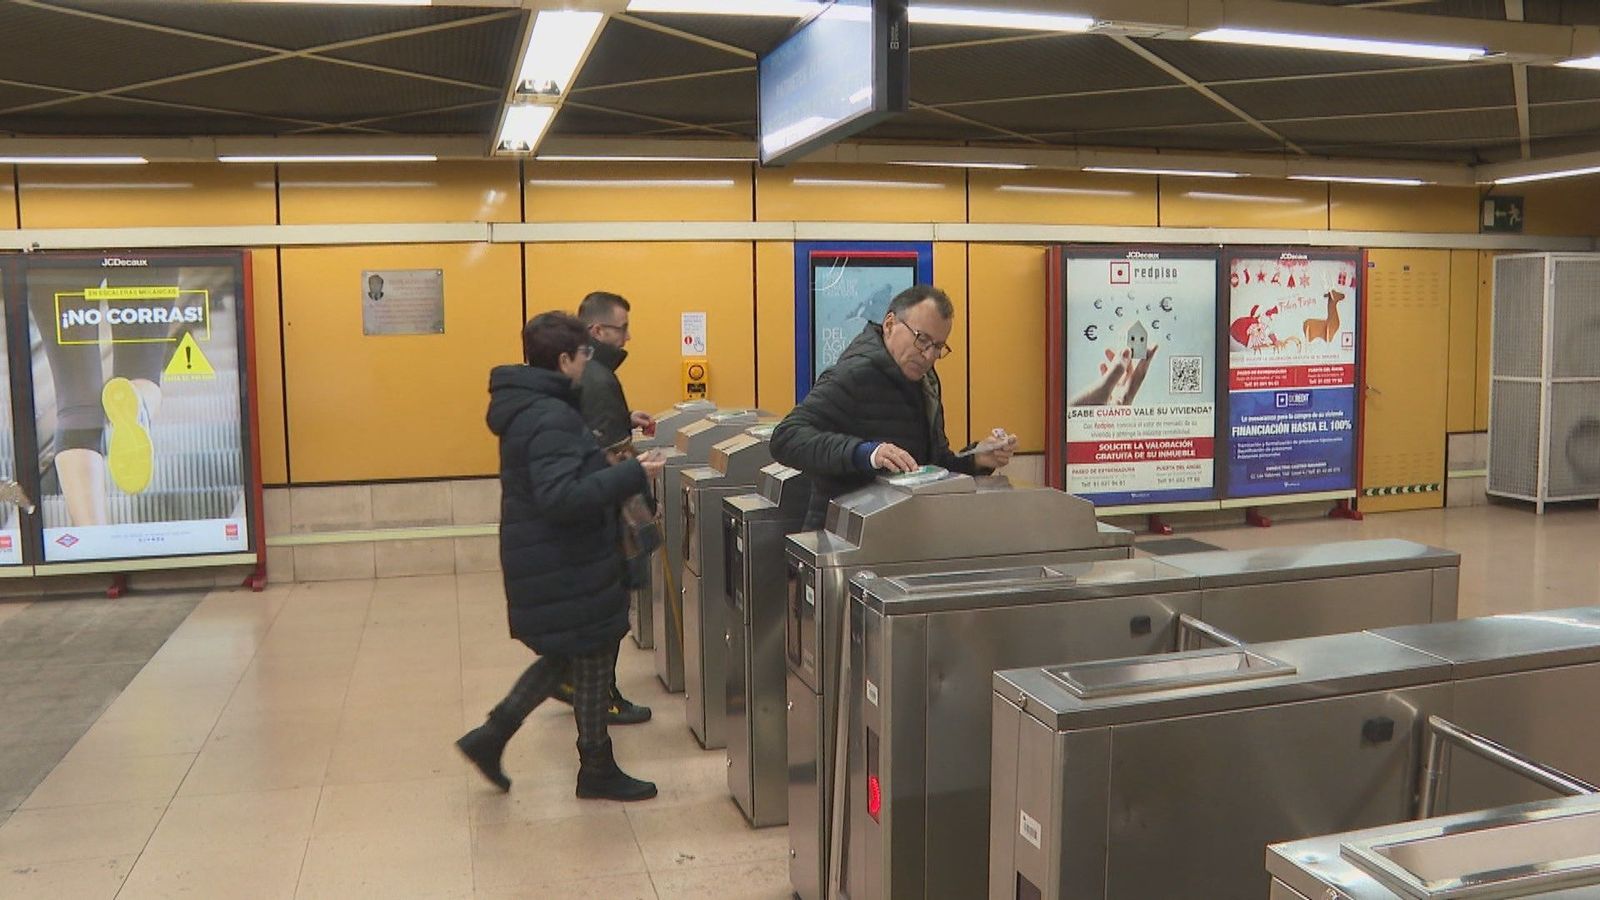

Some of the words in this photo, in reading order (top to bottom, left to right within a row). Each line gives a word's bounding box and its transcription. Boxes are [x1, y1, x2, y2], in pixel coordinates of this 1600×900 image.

[101, 258, 148, 267] JCDecaux
[1134, 267, 1177, 279] redpiso
[62, 308, 102, 329] ¡NO
[106, 306, 203, 325] CORRAS!
[1068, 410, 1094, 419] ¿SABE
[1097, 408, 1131, 416] CUÁNTO
[1134, 408, 1154, 416] VALE
[1157, 407, 1168, 415] SU
[1170, 406, 1213, 415] VIVIENDA?
[1232, 421, 1290, 438] FINANCIACIÓN
[1291, 421, 1317, 433] HASTA
[1319, 421, 1328, 431] EL
[1330, 418, 1352, 431] 100%
[1145, 440, 1193, 449] VALORACIÓN
[1095, 451, 1133, 460] GRATUITA
[1135, 451, 1145, 459] DE
[1147, 450, 1157, 458] SU
[1159, 449, 1196, 458] INMUEBLE
